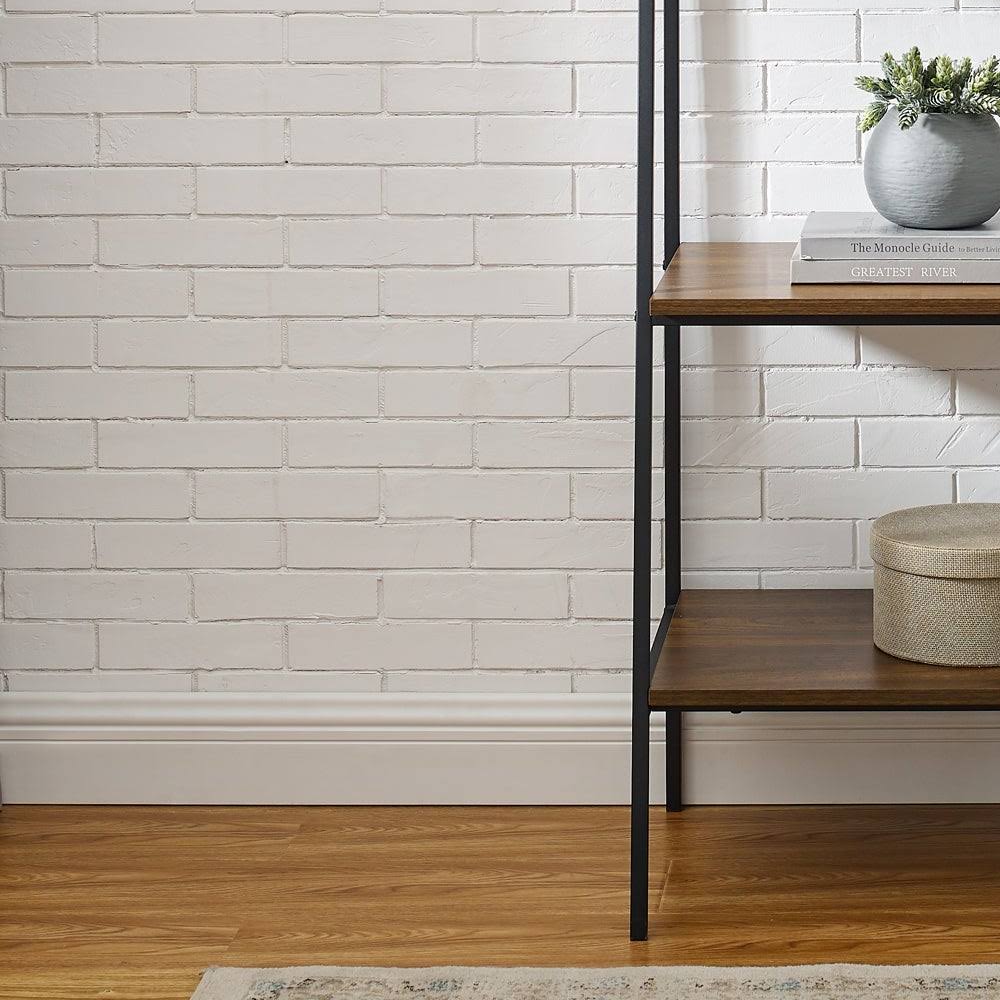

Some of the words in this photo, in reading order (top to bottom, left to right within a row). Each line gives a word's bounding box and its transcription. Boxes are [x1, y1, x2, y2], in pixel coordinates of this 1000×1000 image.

[850, 243, 871, 253] The
[874, 242, 920, 253] Monocle
[922, 242, 955, 253] Guide
[851, 266, 913, 277] GREATEST
[921, 267, 957, 277] RIVER
